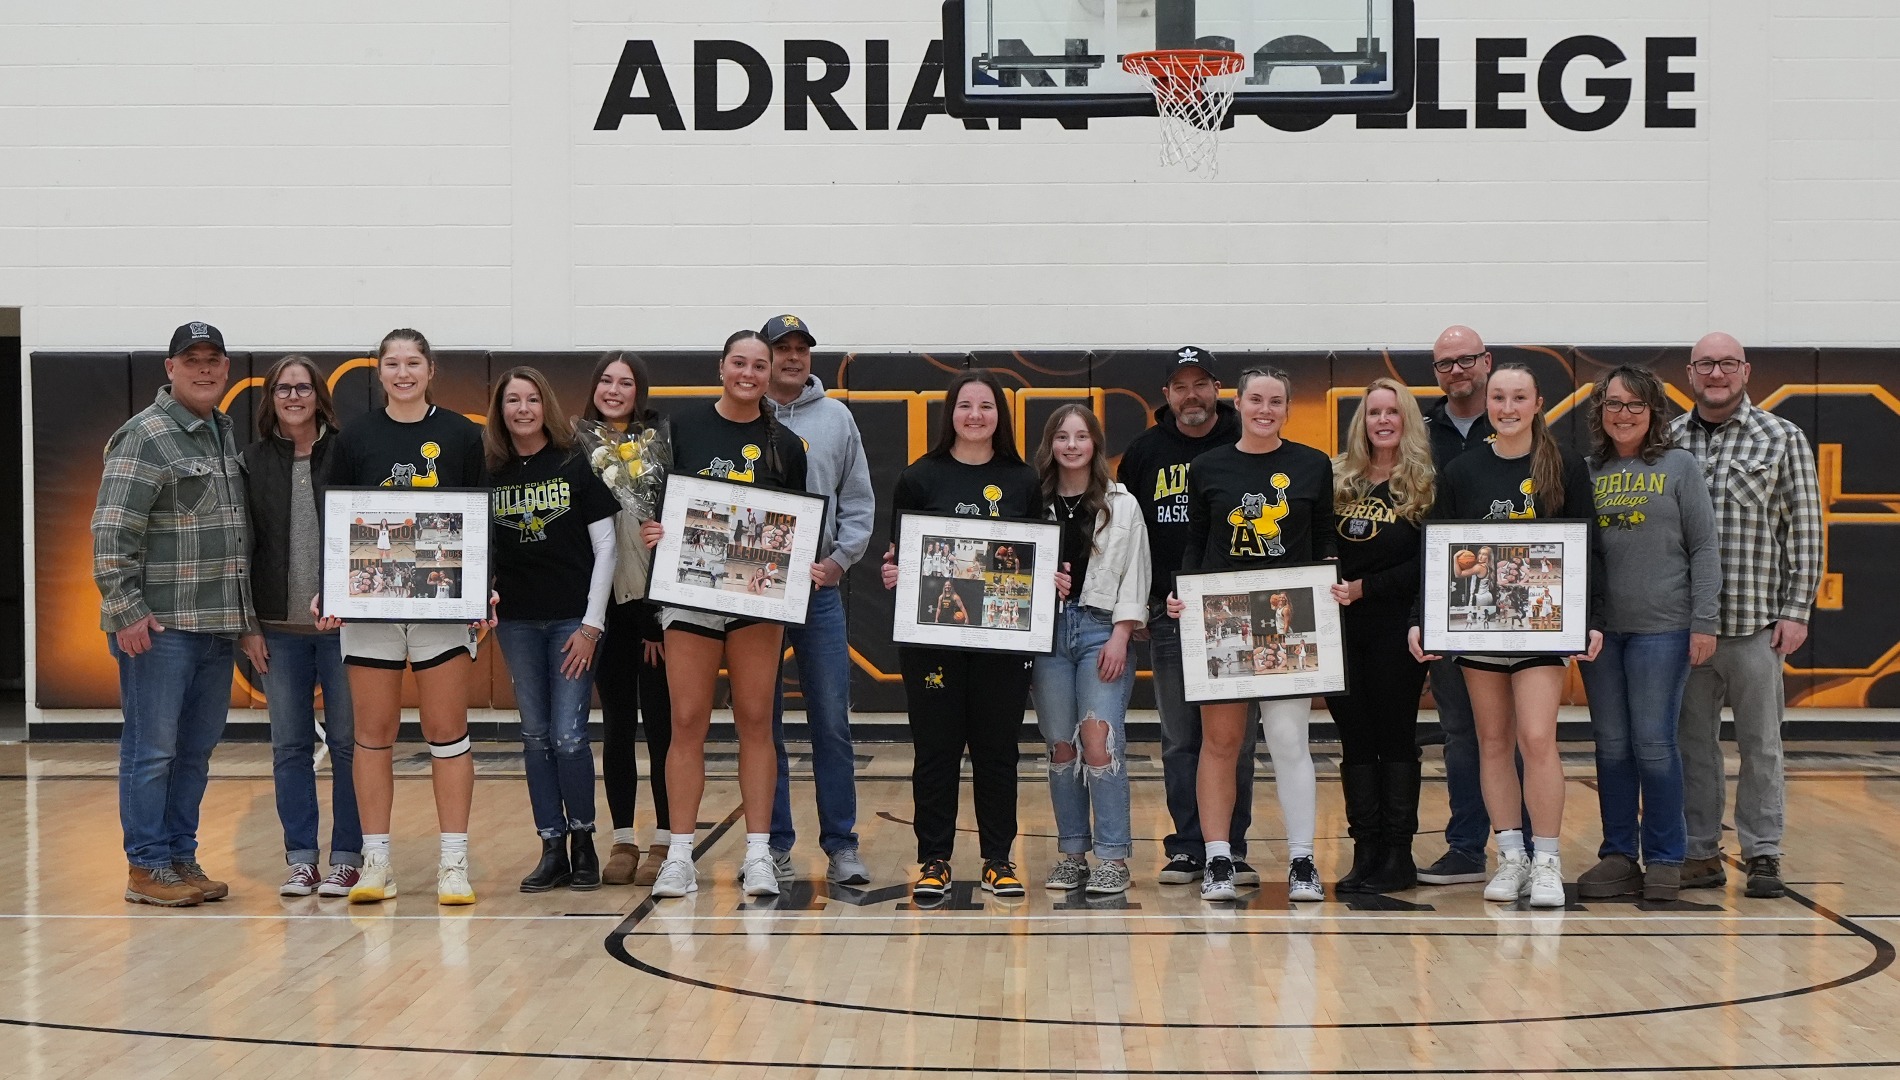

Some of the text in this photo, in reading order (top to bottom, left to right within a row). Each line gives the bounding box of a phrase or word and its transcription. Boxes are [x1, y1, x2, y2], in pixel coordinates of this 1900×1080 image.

[1156, 34, 1697, 133] OLLEGE
[525, 477, 564, 489] COLLEGE
[493, 482, 571, 516] ULLDOGS
[1594, 493, 1649, 510] College
